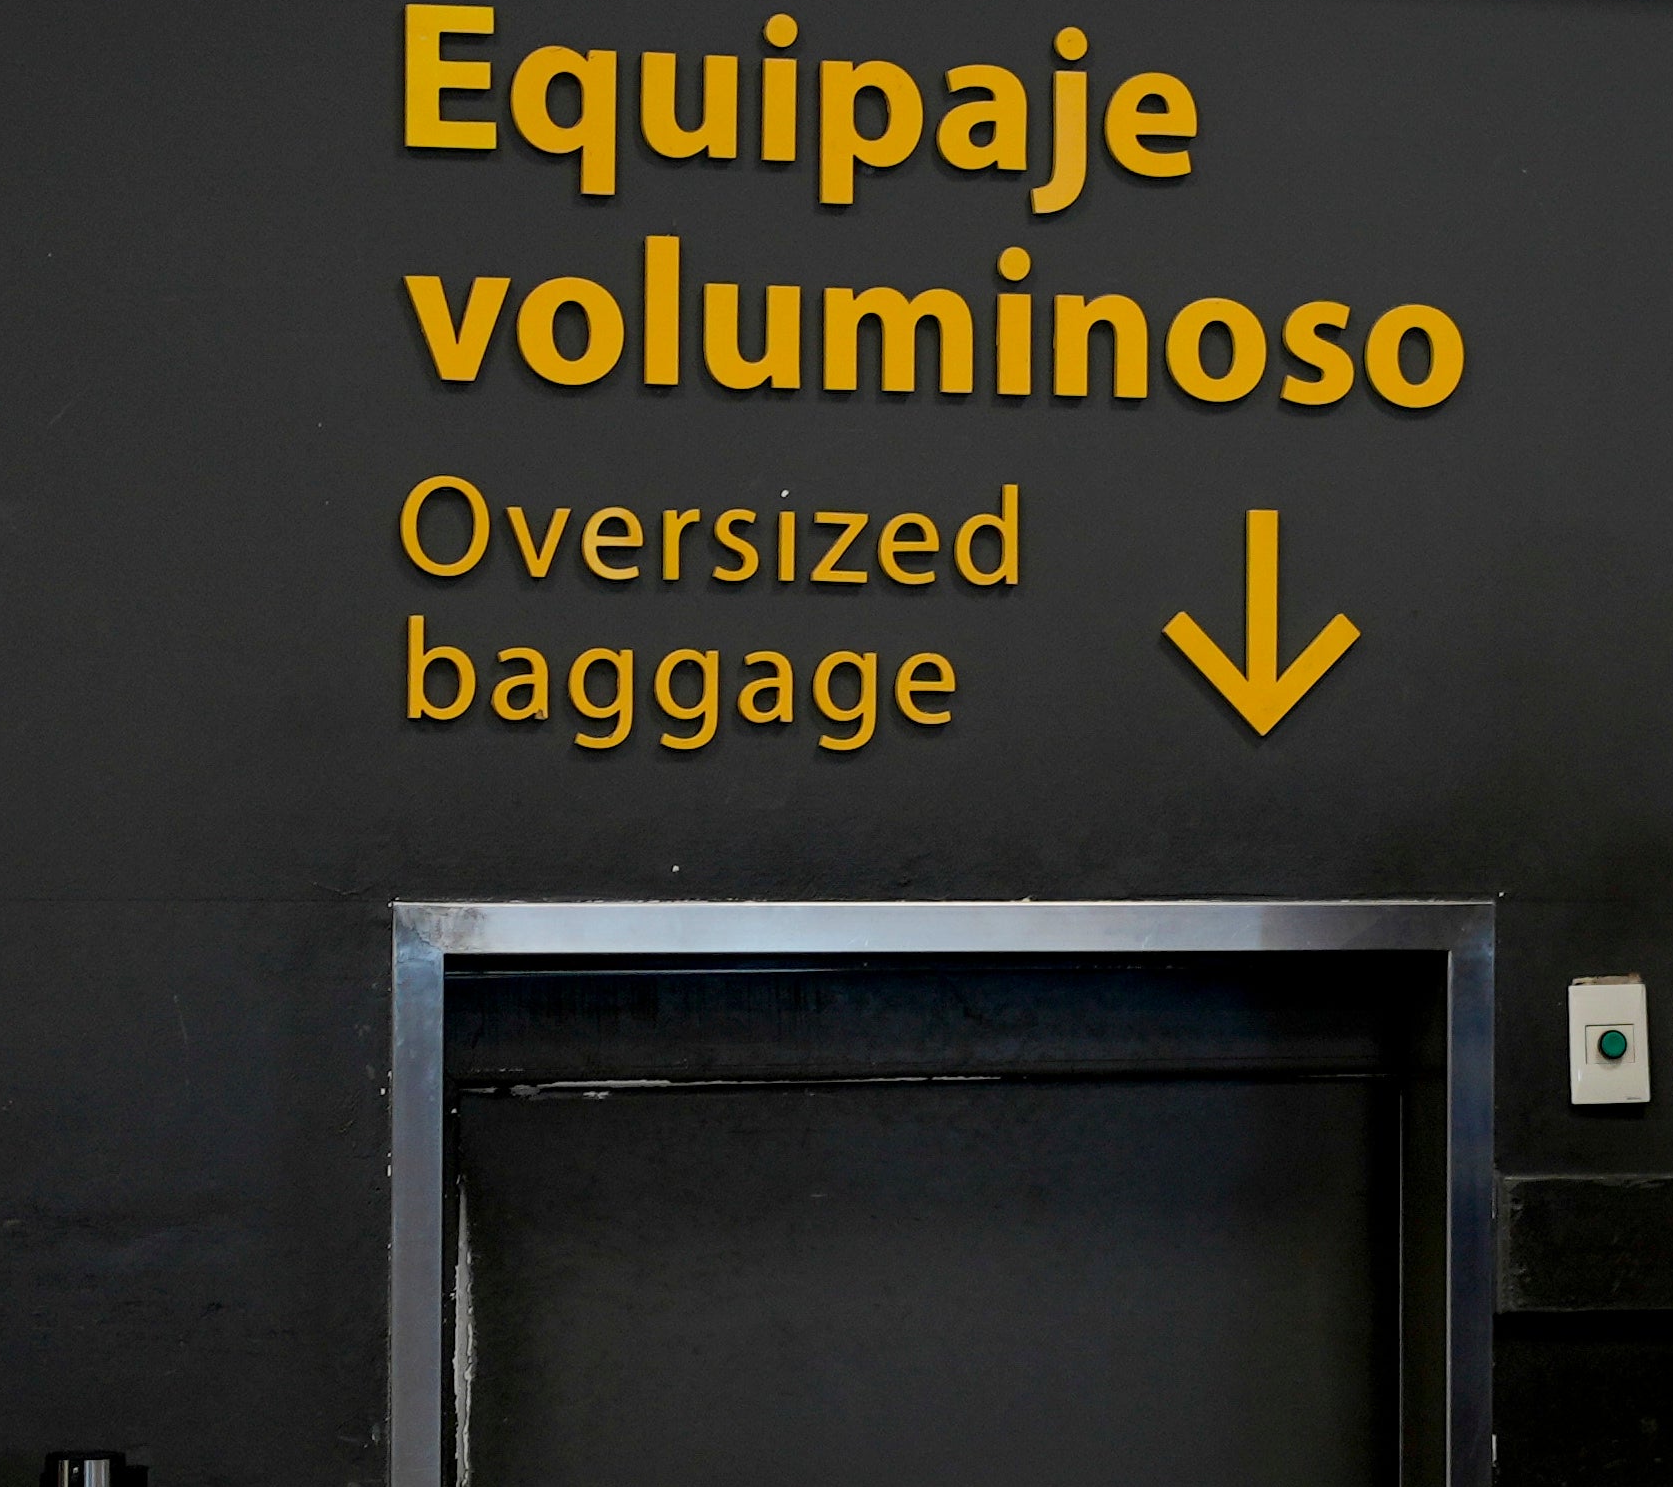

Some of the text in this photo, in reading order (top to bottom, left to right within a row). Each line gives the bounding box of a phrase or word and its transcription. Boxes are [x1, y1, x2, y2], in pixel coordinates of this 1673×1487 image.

[404, 2, 1200, 215] Equipaje
[403, 233, 1466, 410] voluminoso
[399, 474, 1021, 587] Oversized
[406, 613, 958, 752] baggage
